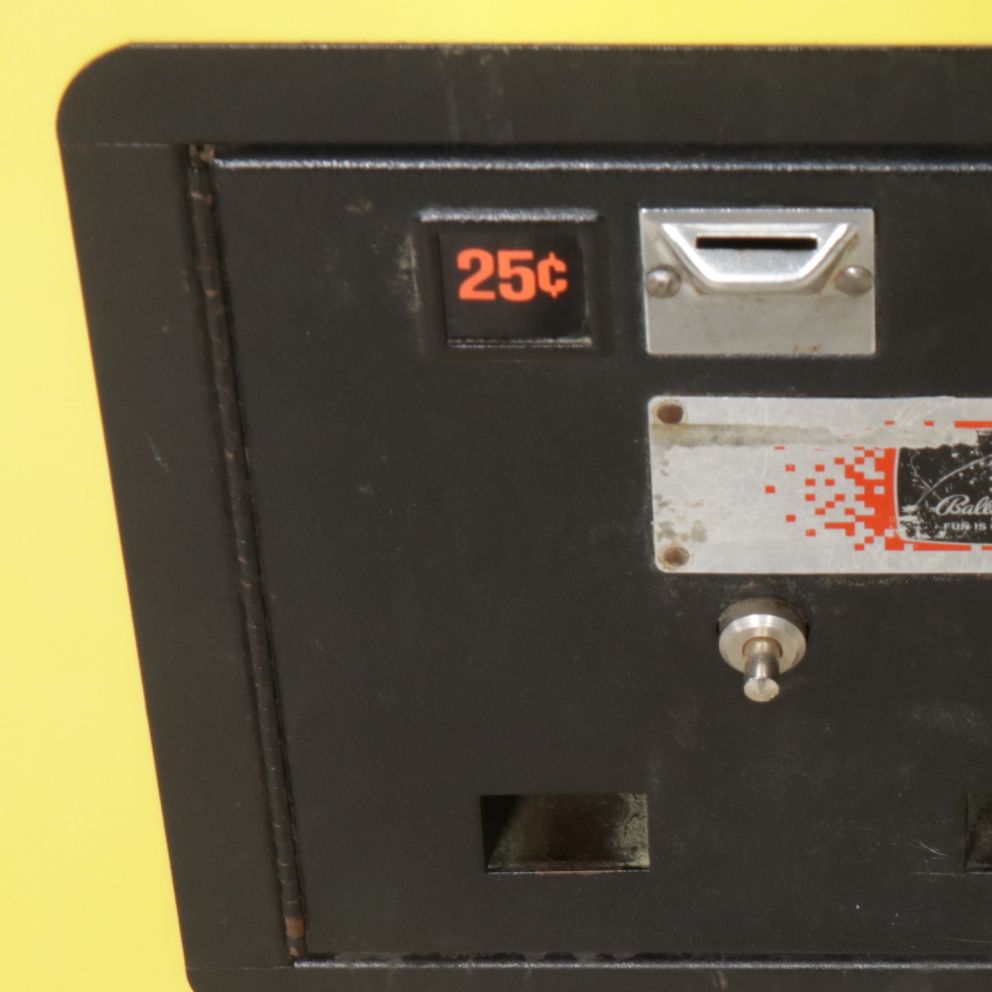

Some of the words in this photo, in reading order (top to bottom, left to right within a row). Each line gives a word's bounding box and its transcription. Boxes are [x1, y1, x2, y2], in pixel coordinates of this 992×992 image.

[456, 247, 568, 302] 25¢
[944, 522, 971, 531] FUN
[974, 522, 987, 531] IS
